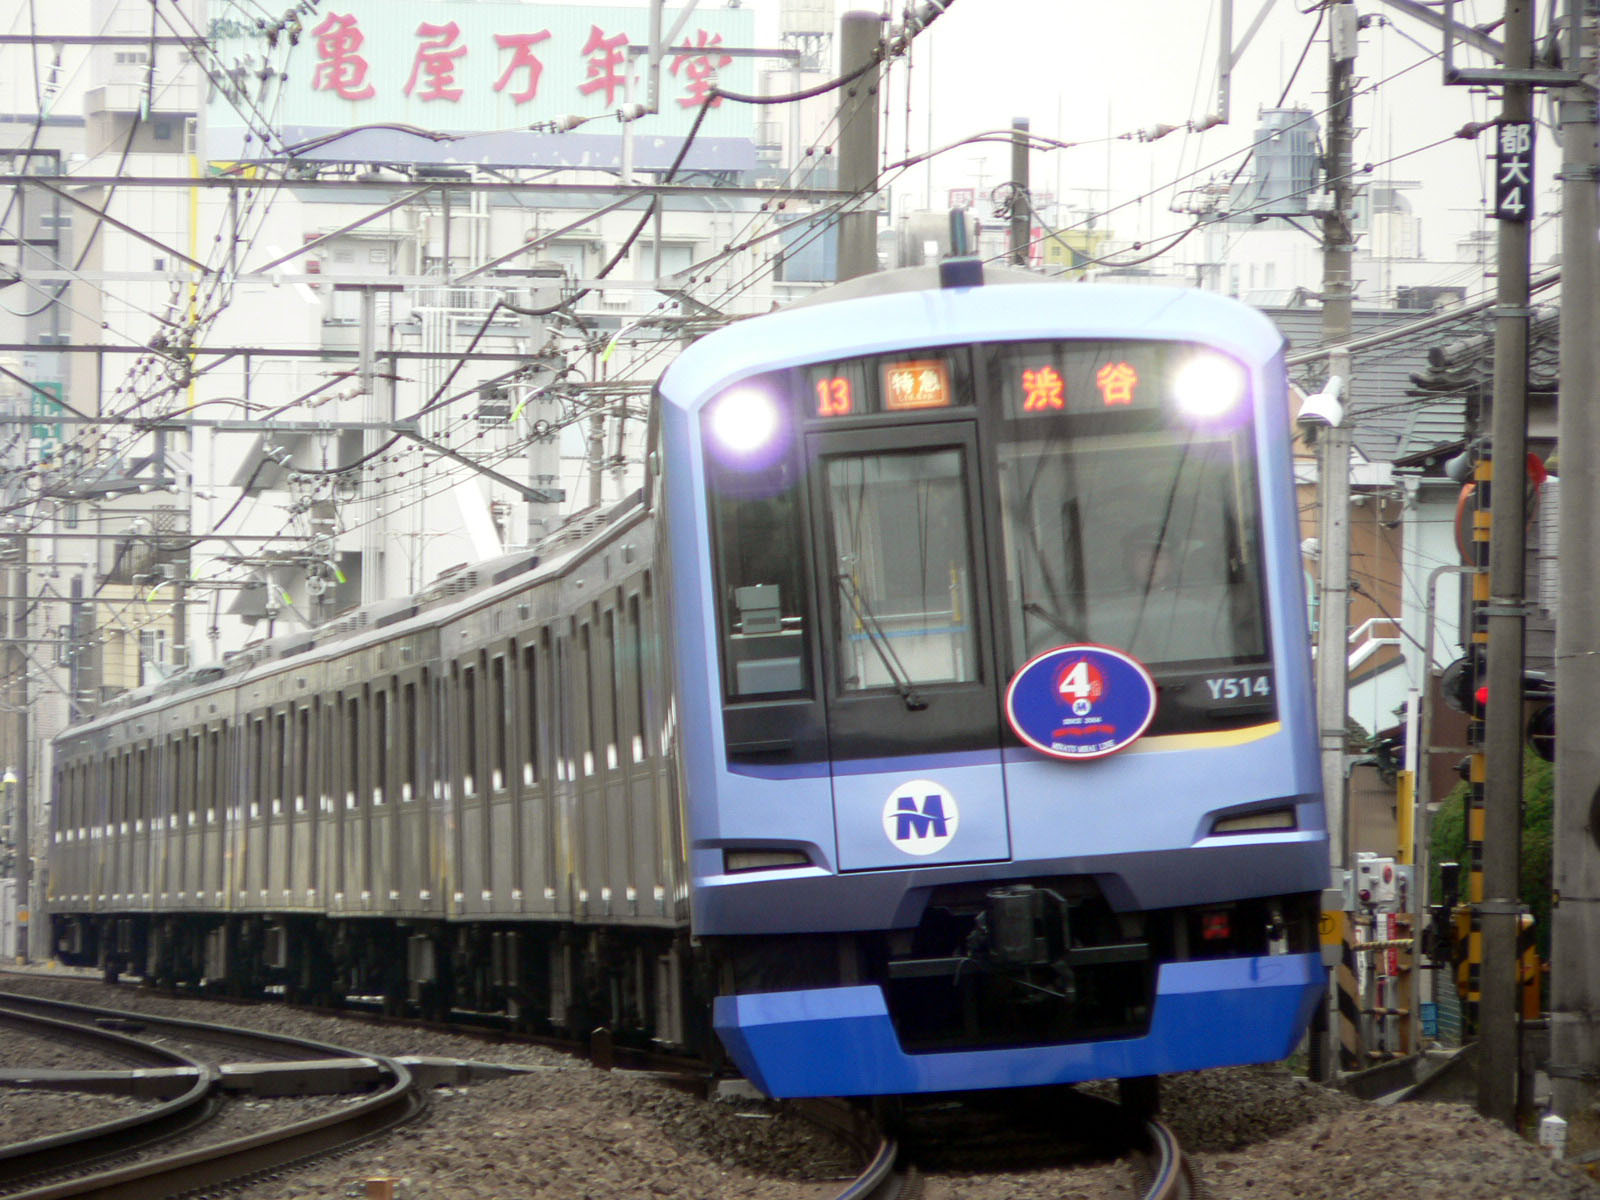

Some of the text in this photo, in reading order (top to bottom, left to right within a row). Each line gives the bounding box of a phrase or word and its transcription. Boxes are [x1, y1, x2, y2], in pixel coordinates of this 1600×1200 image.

[309, 12, 732, 108] 亀屋万年堂
[1501, 124, 1530, 214] 都大4
[816, 378, 850, 415] 13
[1023, 361, 1137, 411] 渋谷
[1206, 676, 1271, 699] Y514
